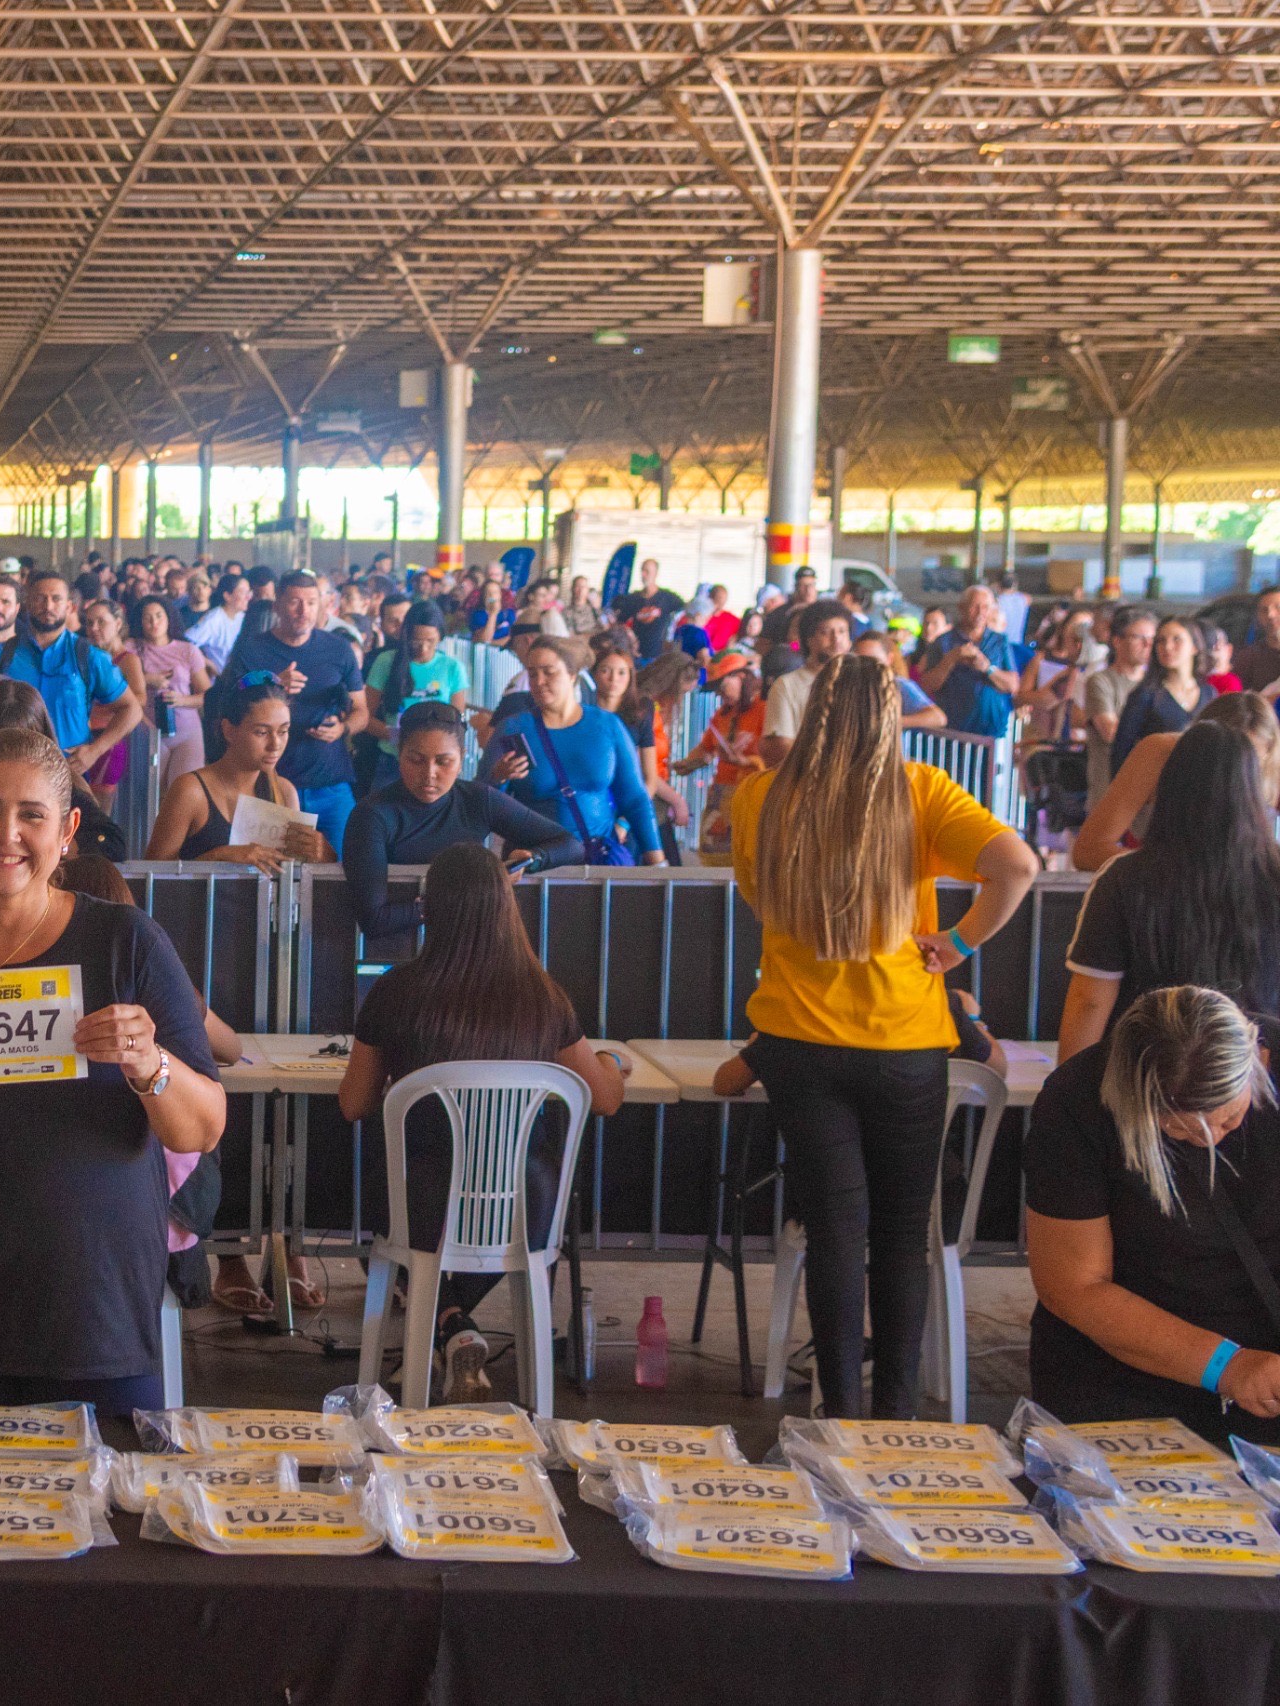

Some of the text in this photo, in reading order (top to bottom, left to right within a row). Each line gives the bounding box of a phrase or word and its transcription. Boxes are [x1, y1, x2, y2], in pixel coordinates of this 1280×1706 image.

[8, 1045, 40, 1054] MATOS
[224, 1425, 336, 1441] 55901
[402, 1424, 514, 1440] 56201
[594, 1438, 708, 1456] 56501
[860, 1434, 976, 1450] 56801
[1095, 1436, 1184, 1452] 5710
[402, 1473, 519, 1492] 56101
[866, 1474, 984, 1488] 56701
[670, 1482, 790, 1500] 56401
[224, 1508, 346, 1524] 55701
[414, 1513, 537, 1533] 56001
[694, 1528, 821, 1550] 56301
[910, 1527, 1034, 1545] 56601
[1132, 1526, 1258, 1546] 56901
